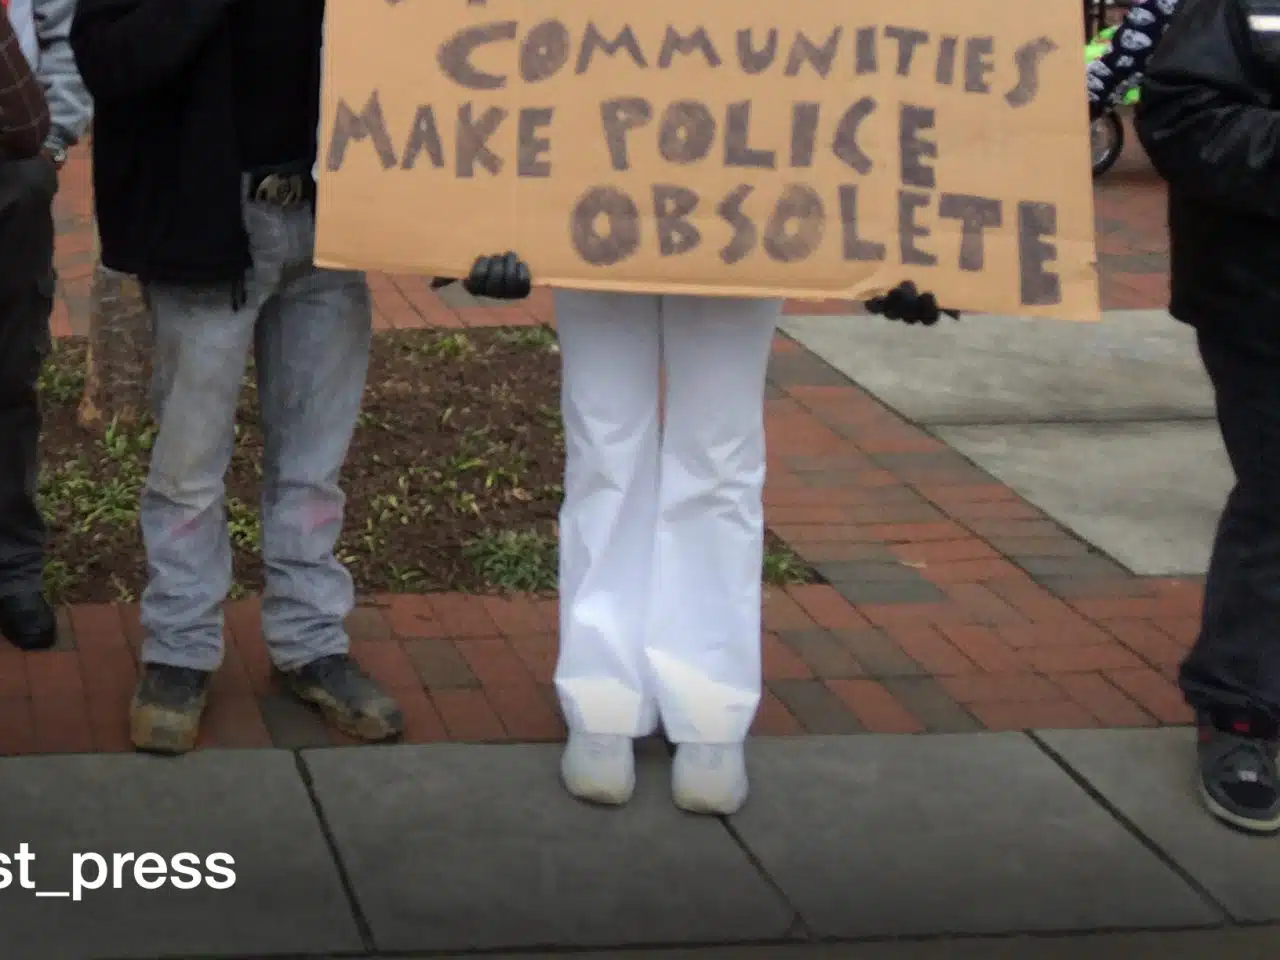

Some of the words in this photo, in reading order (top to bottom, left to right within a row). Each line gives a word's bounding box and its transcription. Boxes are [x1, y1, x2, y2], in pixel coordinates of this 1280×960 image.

[436, 19, 1059, 107] COMMUNITIES
[326, 90, 553, 179] MAKE
[601, 96, 939, 188] POLICE
[569, 183, 1060, 307] OBSOLETE
